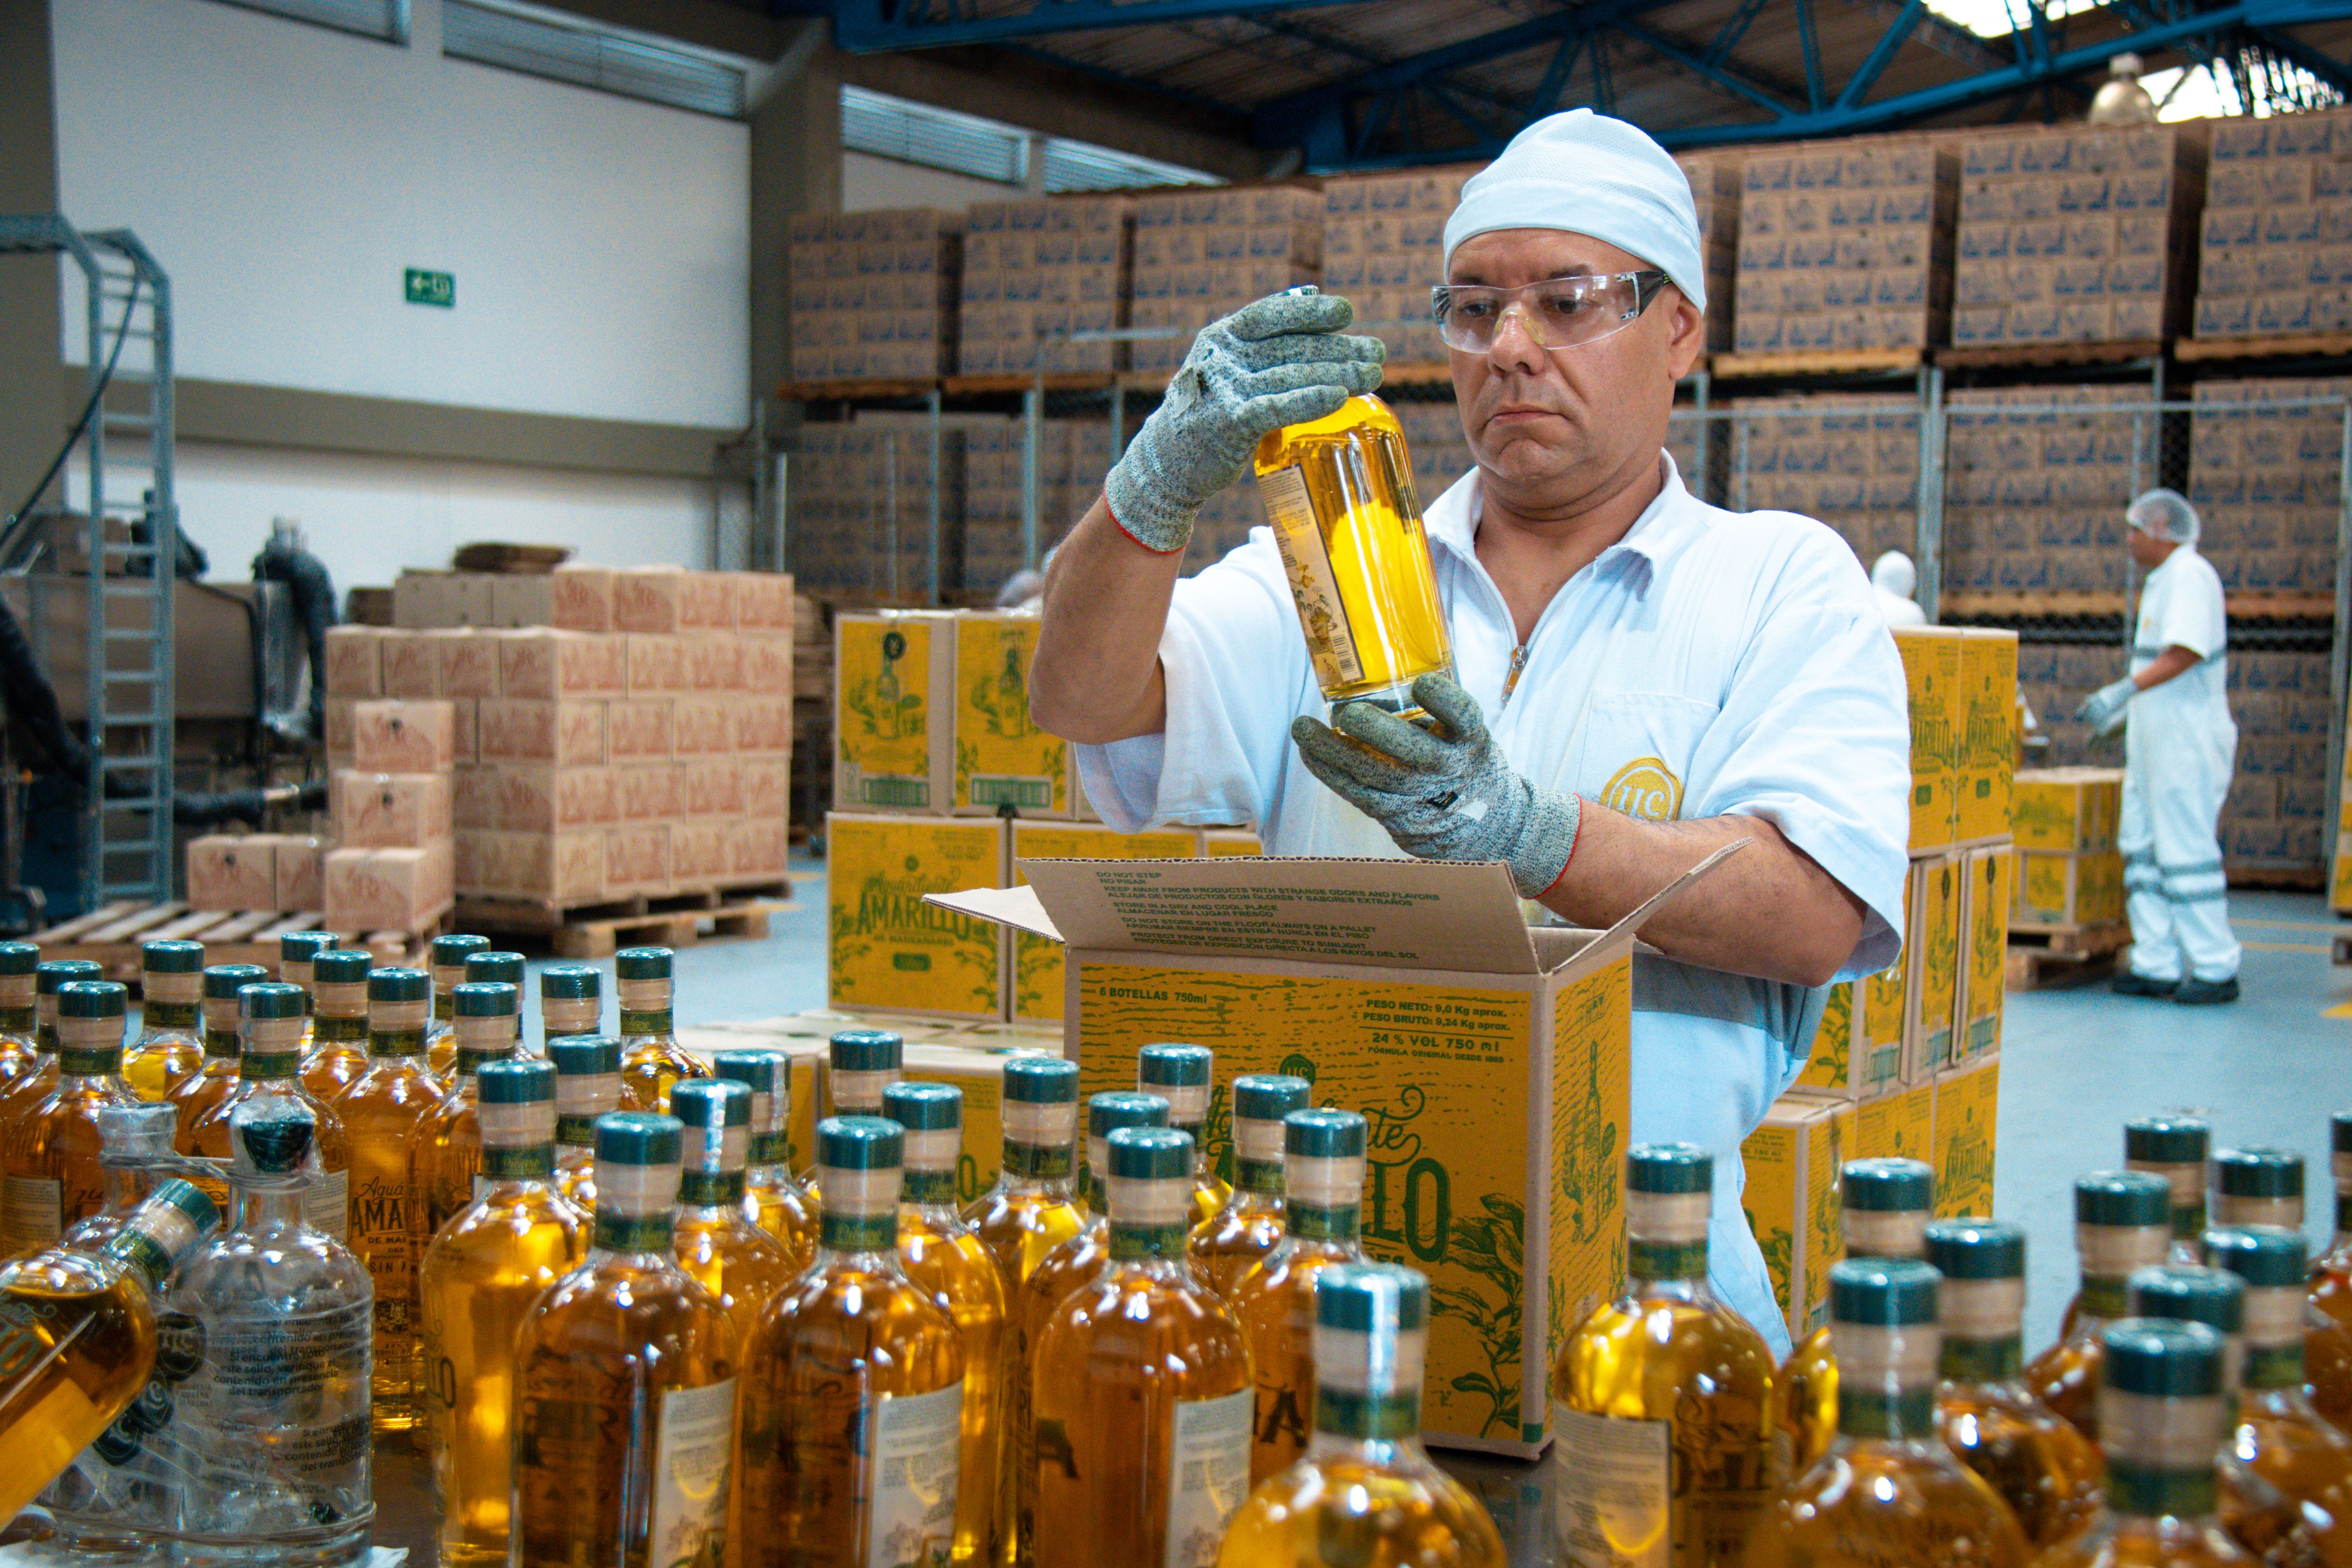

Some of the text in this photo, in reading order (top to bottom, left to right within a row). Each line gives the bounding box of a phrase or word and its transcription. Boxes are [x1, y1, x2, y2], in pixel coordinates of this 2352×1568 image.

[1392, 892, 1440, 901] FLAVORS
[857, 891, 970, 940] AMARILLO
[1317, 941, 1366, 949] SUNLIGHT
[1099, 986, 1208, 1004] 6 BOTELLAS 750ml
[1366, 999, 1507, 1019] PESO NETO: 9,0 Kg aprox.
[1363, 1012, 1511, 1031] PESO BRUTO: 9,24 Kg aprox.
[1372, 1033, 1389, 1043] 24
[1393, 1034, 1404, 1045] %
[1409, 1035, 1439, 1048] VOL
[1446, 1038, 1475, 1051] 750
[1412, 1049, 1452, 1060] ORIGINAL
[1455, 1053, 1483, 1062] DESDE
[369, 1262, 393, 1273] SIN
[214, 1374, 271, 1385] contenido
[289, 1368, 338, 1383] presencia
